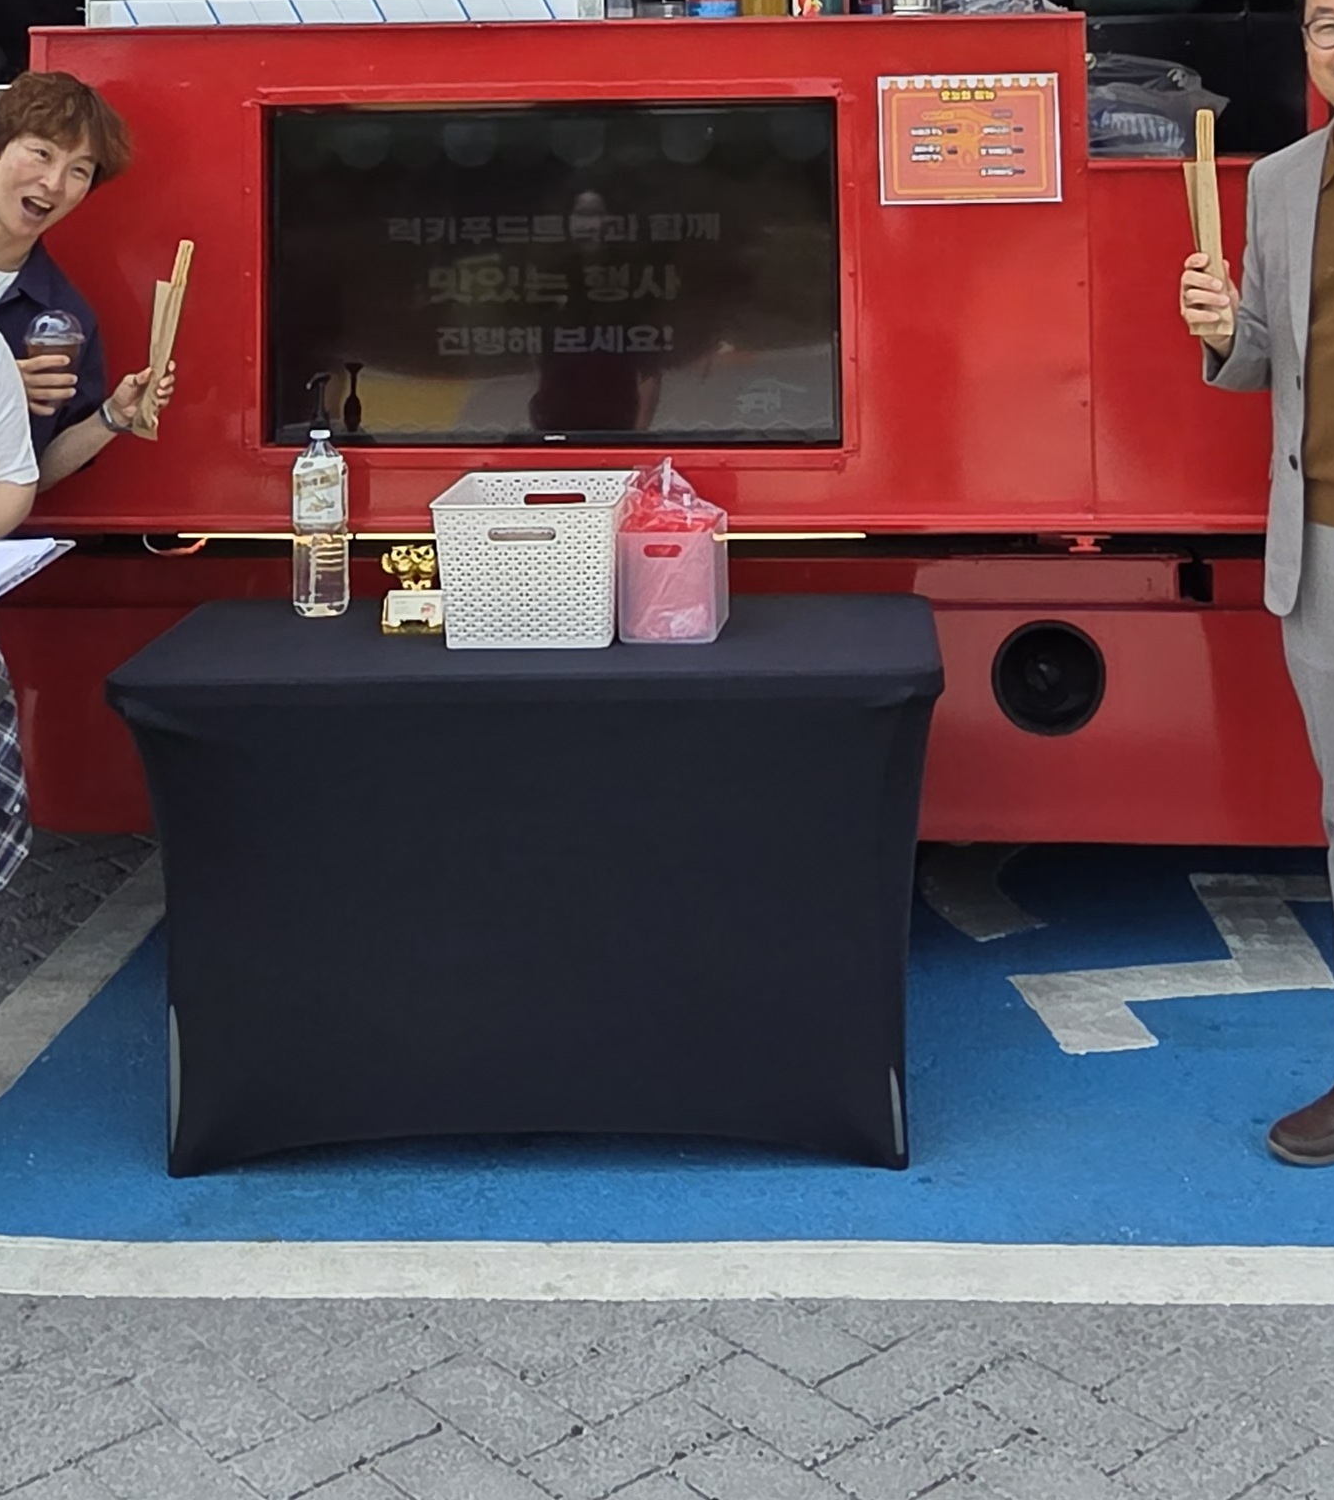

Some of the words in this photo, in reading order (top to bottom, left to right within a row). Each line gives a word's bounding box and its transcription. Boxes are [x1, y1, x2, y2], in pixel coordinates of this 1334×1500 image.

[647, 212, 721, 243] 함께
[427, 263, 570, 306] 맛있는
[584, 263, 681, 303] 행사
[436, 325, 542, 357] 진행해
[553, 324, 674, 355] 보세요!
